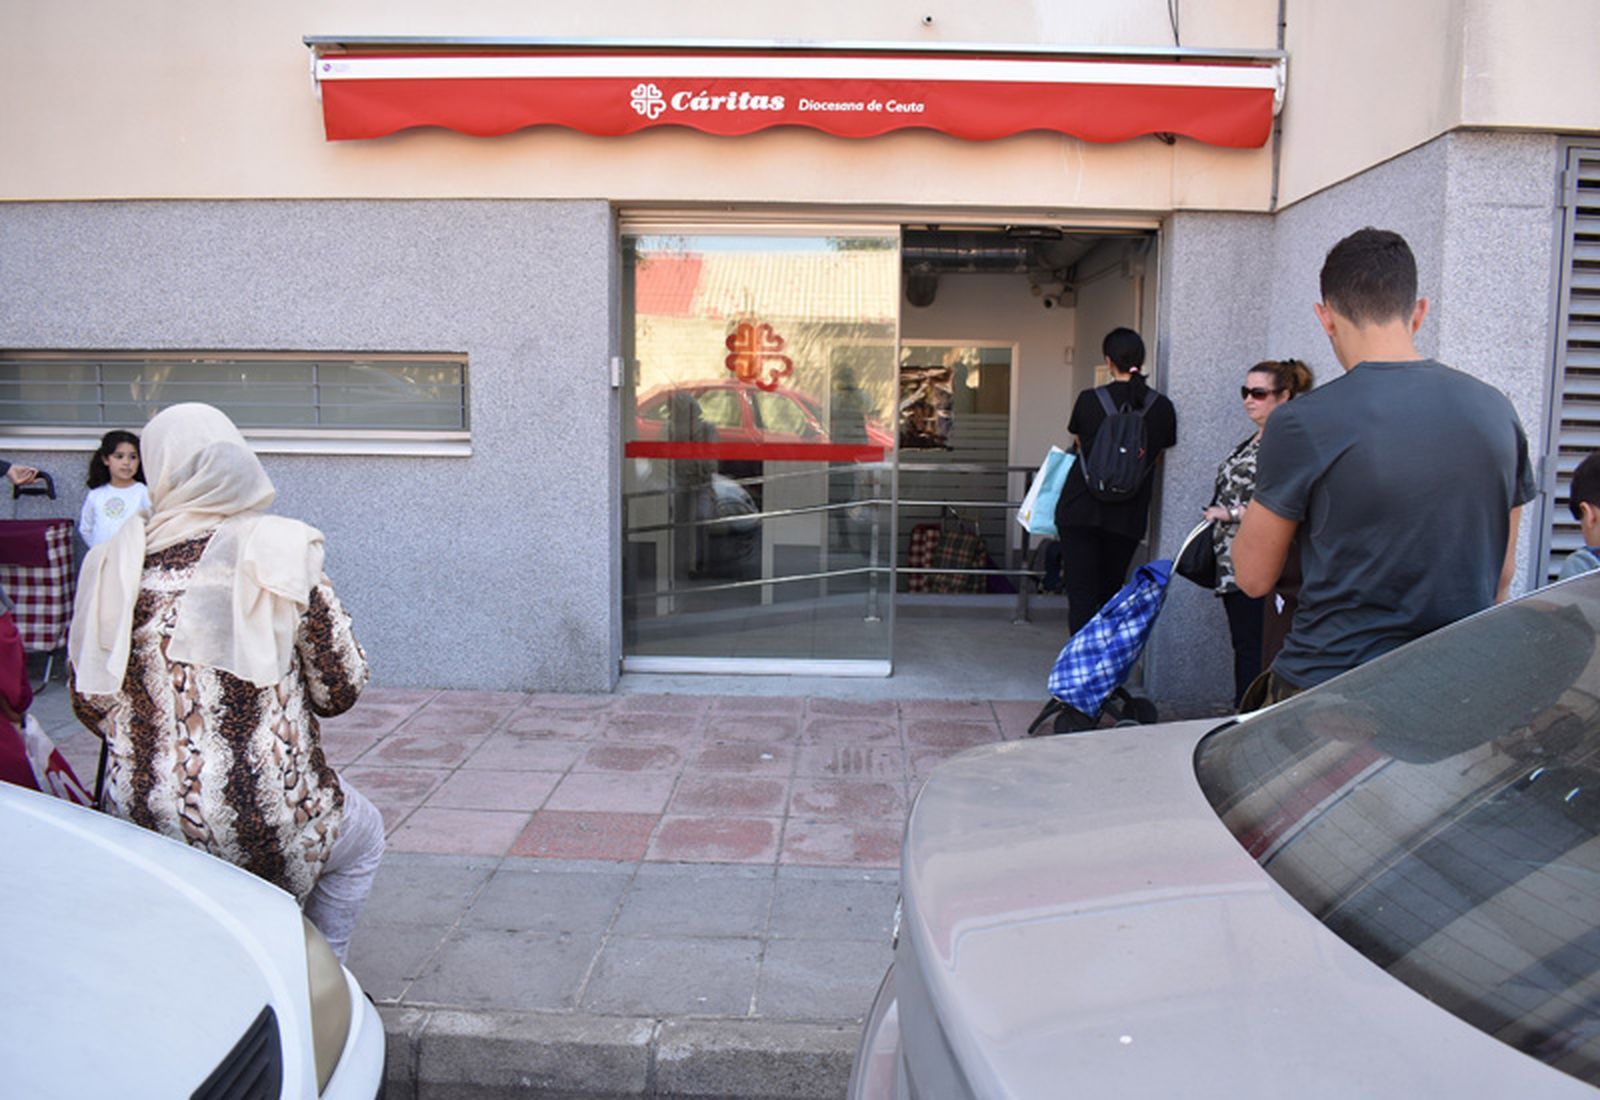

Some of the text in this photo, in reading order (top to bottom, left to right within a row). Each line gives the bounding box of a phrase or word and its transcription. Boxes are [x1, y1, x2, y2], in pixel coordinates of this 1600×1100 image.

[670, 89, 786, 112] Cáritas
[798, 98, 925, 113] Diocesana de Ceuta
